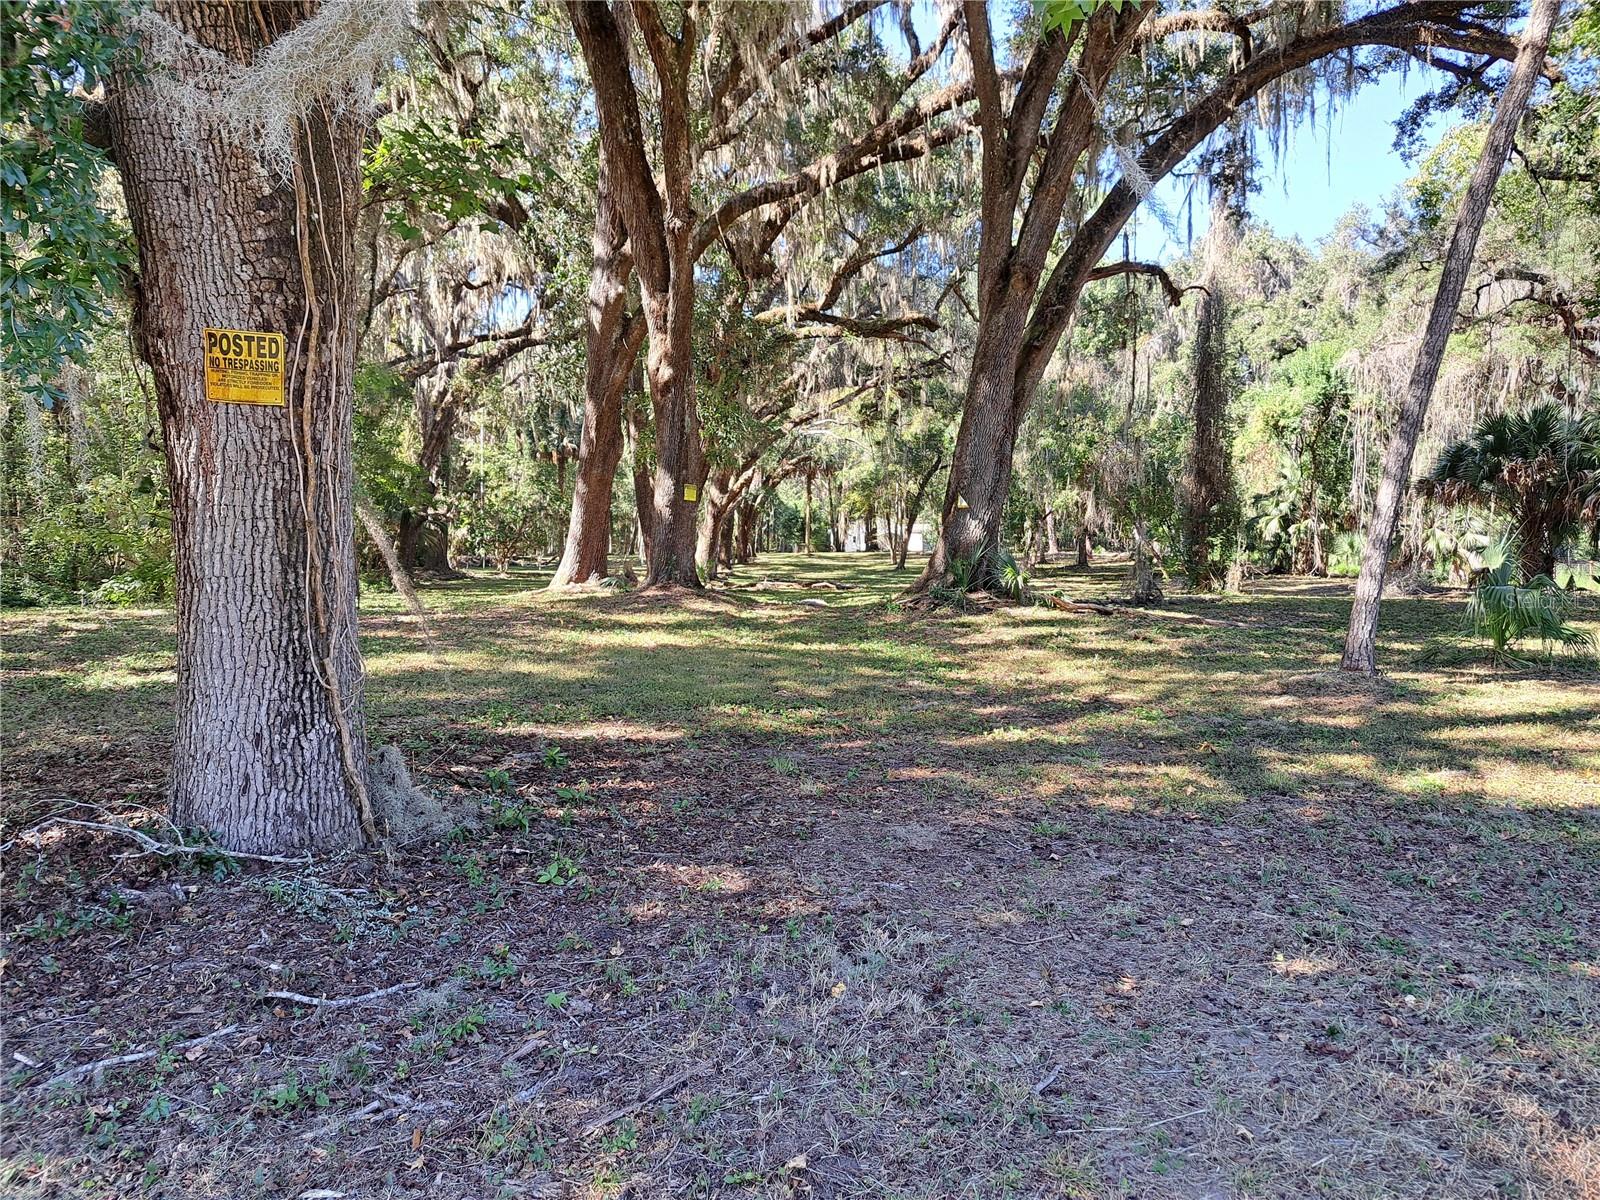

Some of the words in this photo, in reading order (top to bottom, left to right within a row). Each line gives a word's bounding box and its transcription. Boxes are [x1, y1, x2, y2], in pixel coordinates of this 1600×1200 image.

[207, 332, 280, 359] POSTED
[209, 356, 220, 368] NO
[222, 357, 279, 372] TRESPASSING
